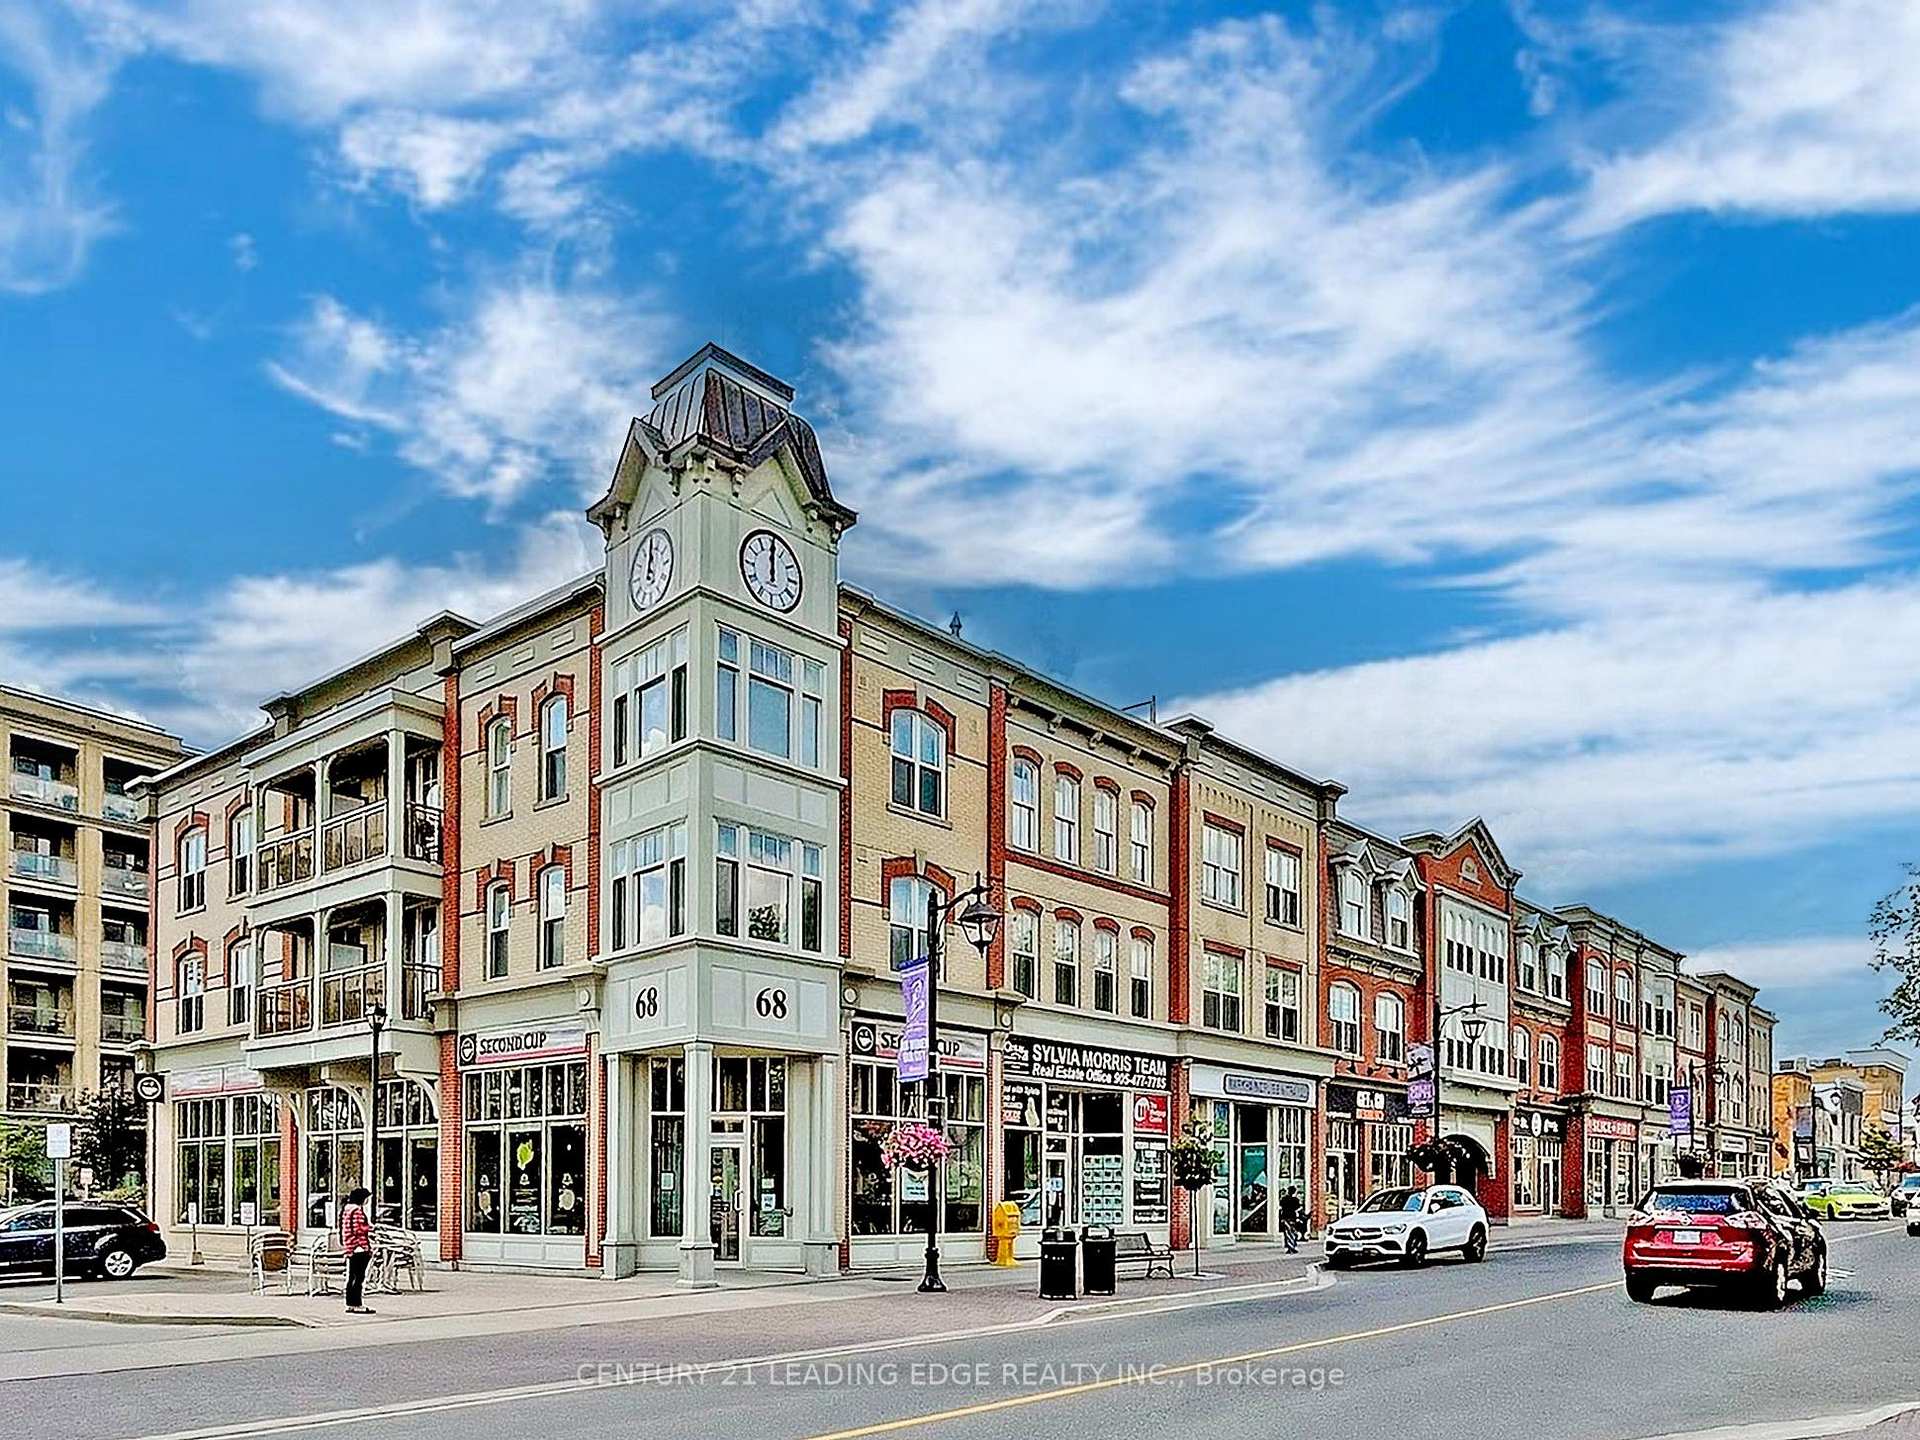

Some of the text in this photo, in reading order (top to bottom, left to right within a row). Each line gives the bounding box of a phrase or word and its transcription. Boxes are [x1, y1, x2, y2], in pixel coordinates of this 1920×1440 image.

[635, 986, 658, 1020] 68
[756, 987, 787, 1020] 68
[479, 1031, 548, 1055] SECOND CUP
[1032, 1044, 1080, 1067] SYLVIA
[1082, 1050, 1132, 1072] MORRIS
[1134, 1056, 1166, 1076] TEAM
[1032, 1064, 1054, 1078] Real
[1056, 1065, 1084, 1081] Estate
[1086, 1067, 1112, 1084] Office
